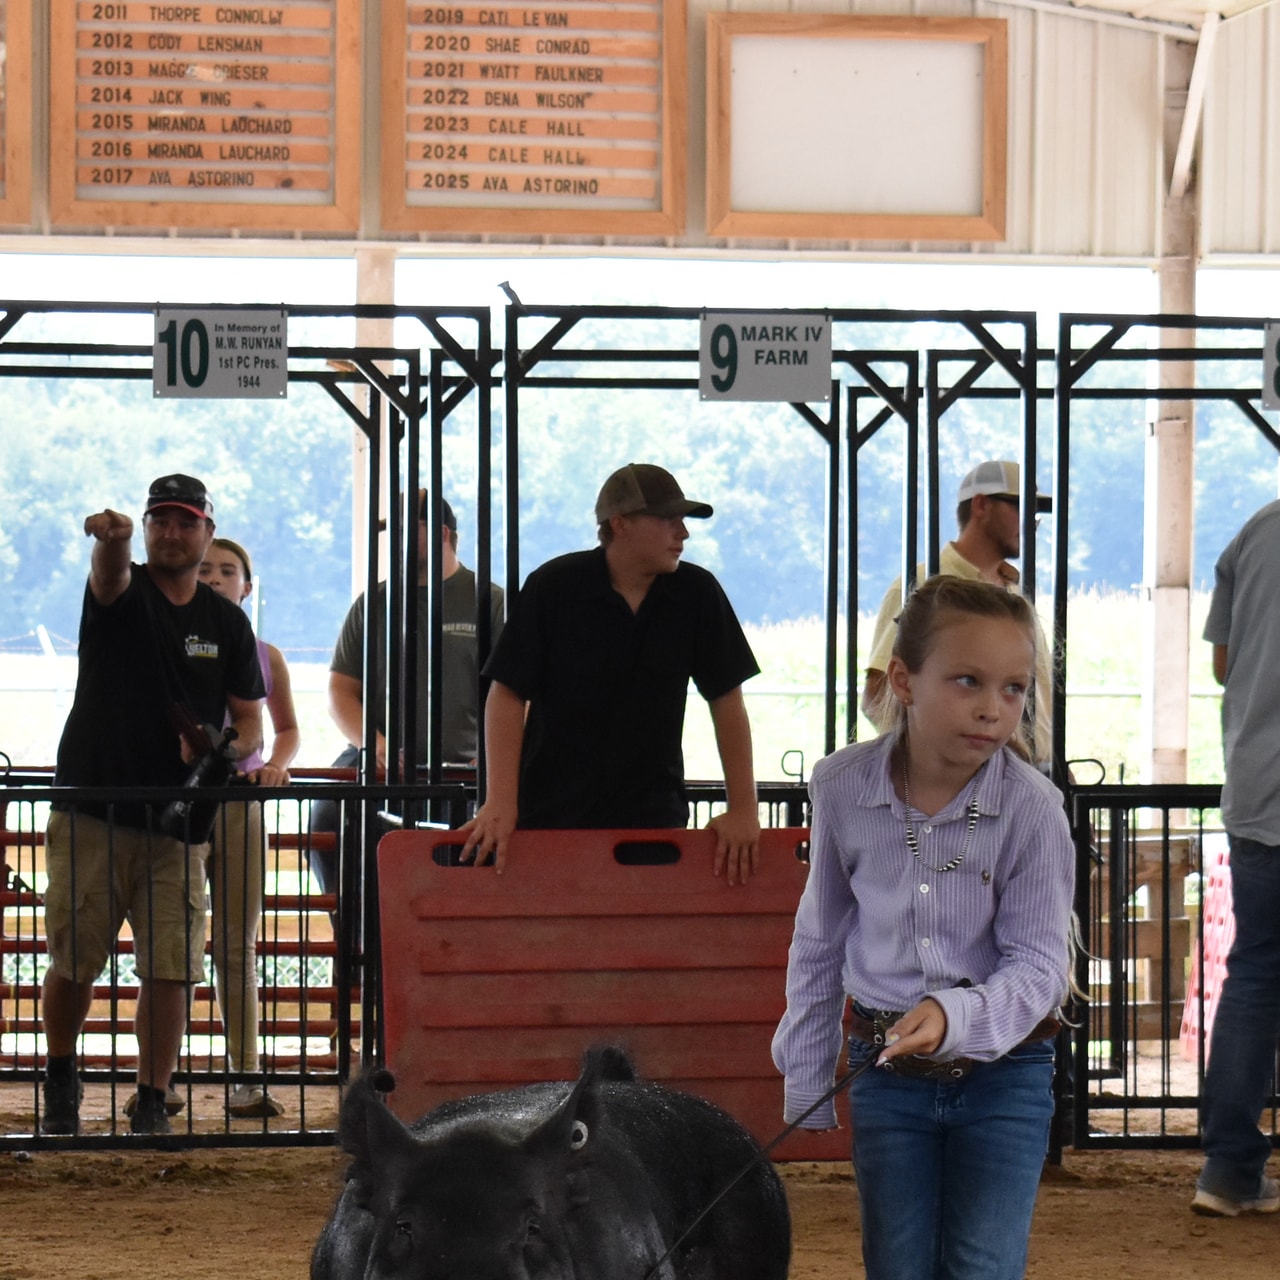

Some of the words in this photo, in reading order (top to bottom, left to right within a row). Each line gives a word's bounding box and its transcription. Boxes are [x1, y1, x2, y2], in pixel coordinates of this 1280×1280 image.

[92, 5, 128, 20] 2011
[149, 6, 201, 23] THORPE
[215, 8, 283, 25] CONNOLLY
[424, 9, 464, 24] 2019
[92, 33, 133, 48] 2012
[147, 34, 182, 50] CODY
[197, 36, 263, 52] LENSMAN
[424, 36, 471, 51] 2020
[485, 38, 521, 53] SHAE
[535, 39, 591, 56] CONRAD
[92, 60, 133, 76] 2013
[424, 62, 465, 78] 2021
[479, 64, 520, 79] WYATT
[534, 66, 604, 83] FAULKNER
[91, 87, 132, 103] 2014
[148, 90, 184, 105] JACK
[199, 91, 231, 106] WING
[423, 90, 470, 105] 2022
[484, 92, 520, 106] DENA
[535, 93, 586, 109] WILSON
[92, 114, 133, 130] 2015
[147, 116, 206, 132] MIRANDA
[221, 118, 292, 135] LAUCHARD
[423, 116, 470, 131] 2023
[488, 119, 527, 134] CALE
[546, 121, 586, 137] HALL
[91, 142, 133, 157] 2016
[147, 144, 204, 159] MIRANDA
[219, 145, 291, 161] LAUCHARD
[422, 145, 468, 160] 2024
[488, 148, 529, 163] CALE
[543, 149, 586, 165] HALL
[91, 169, 133, 184] 2017
[148, 171, 172, 185] AVA
[187, 171, 254, 186] ASTORINO
[423, 174, 470, 189] 2025
[482, 176, 509, 191] AVA
[523, 178, 599, 194] ASTORINO
[214, 324, 224, 332] In
[227, 323, 268, 334] Memory
[270, 324, 280, 333] of
[741, 326, 798, 341] MARK
[805, 326, 823, 342] IV
[158, 318, 209, 388] 10
[215, 337, 238, 349] M.W.
[241, 337, 282, 350] RUNYAN
[219, 356, 233, 369] 1st
[237, 356, 250, 369] PC
[254, 356, 279, 369] Pres.
[710, 323, 738, 393] 9
[755, 350, 808, 365] FARM
[238, 376, 261, 388] 1944
